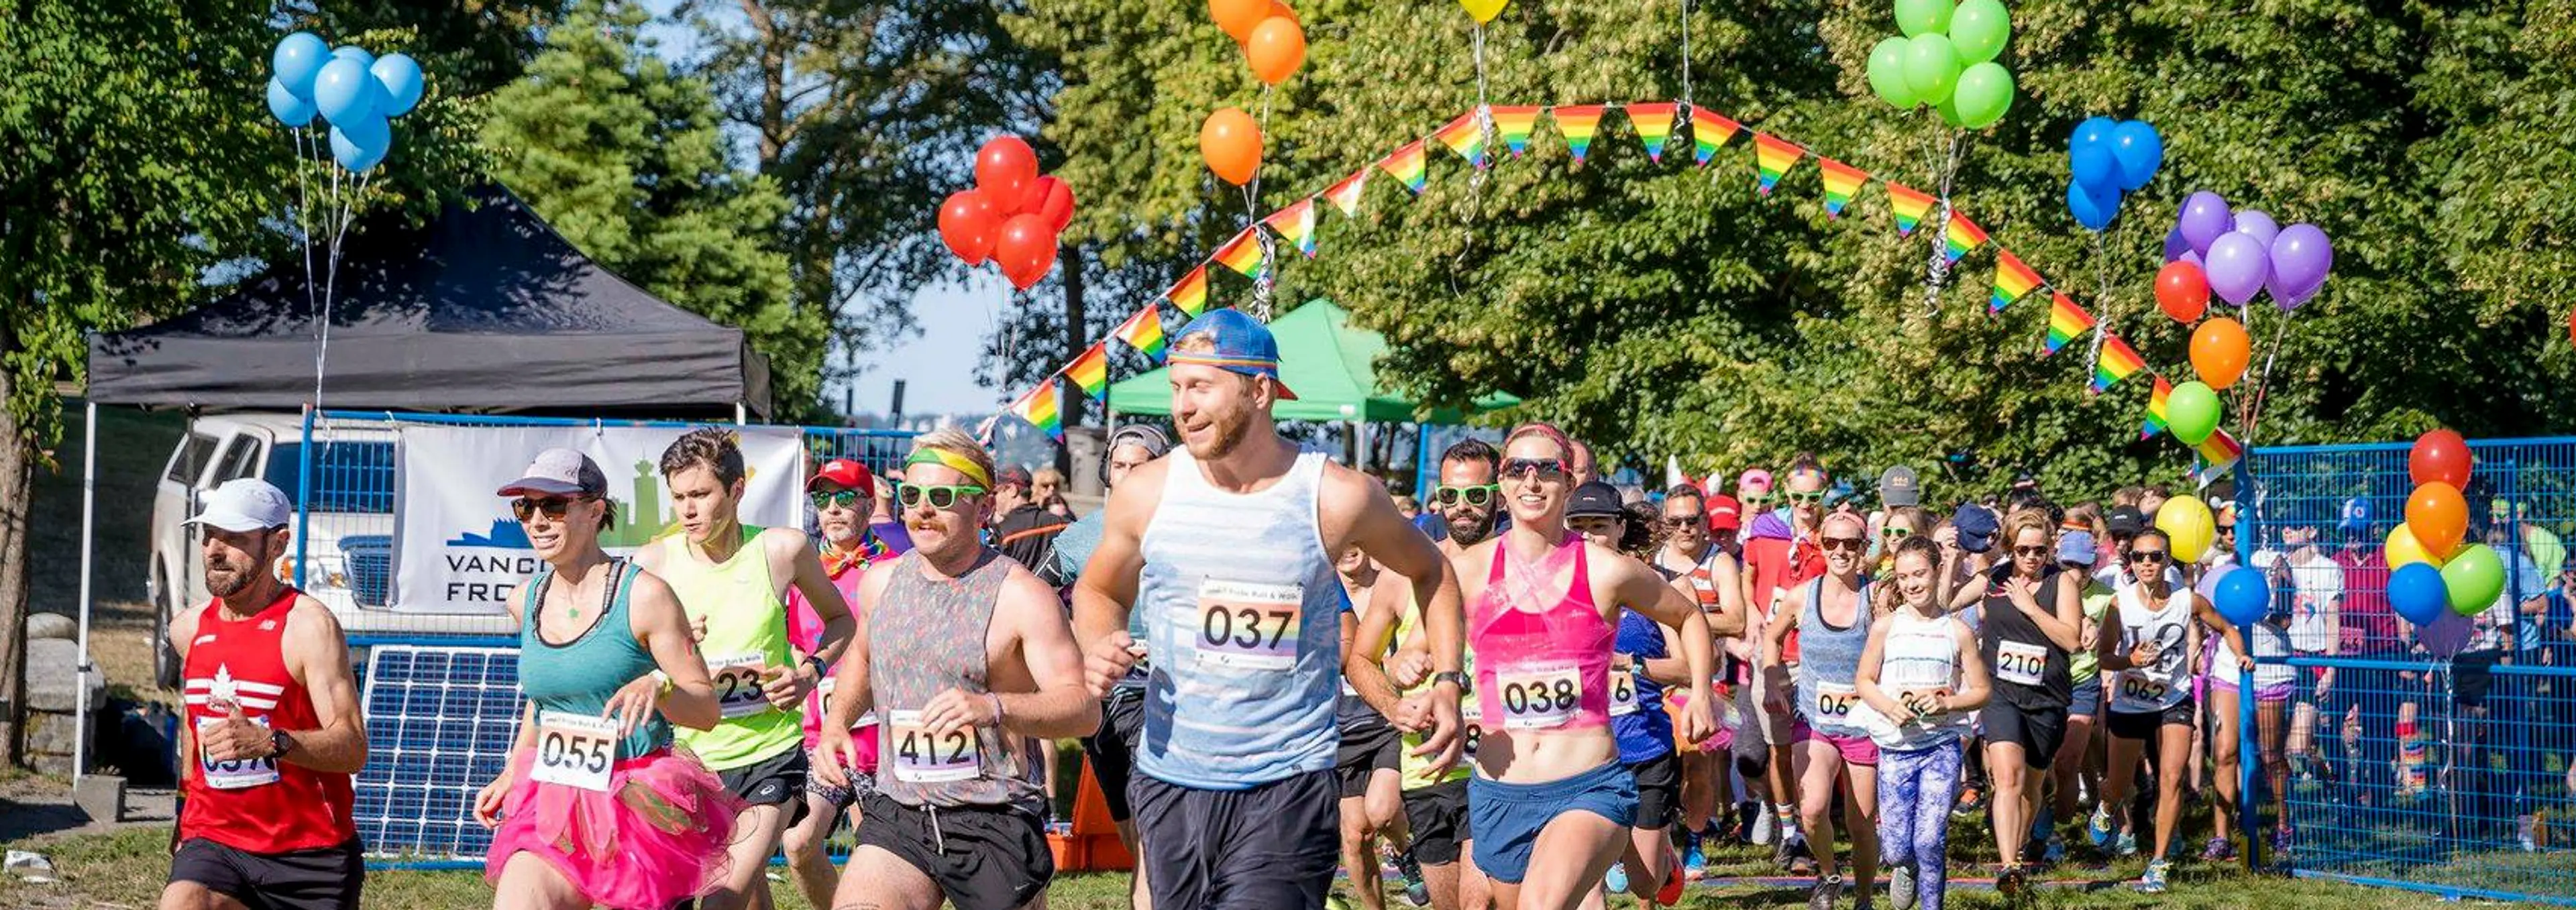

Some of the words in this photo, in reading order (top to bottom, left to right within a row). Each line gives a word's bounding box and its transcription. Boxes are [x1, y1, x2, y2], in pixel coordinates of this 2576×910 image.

[446, 555, 545, 574] VANC
[1205, 605, 1293, 650] 037
[2000, 652, 2041, 676] 210
[1505, 679, 1575, 714] 038
[2126, 679, 2165, 703] 062
[543, 732, 609, 773] 055
[900, 730, 970, 765] 412
